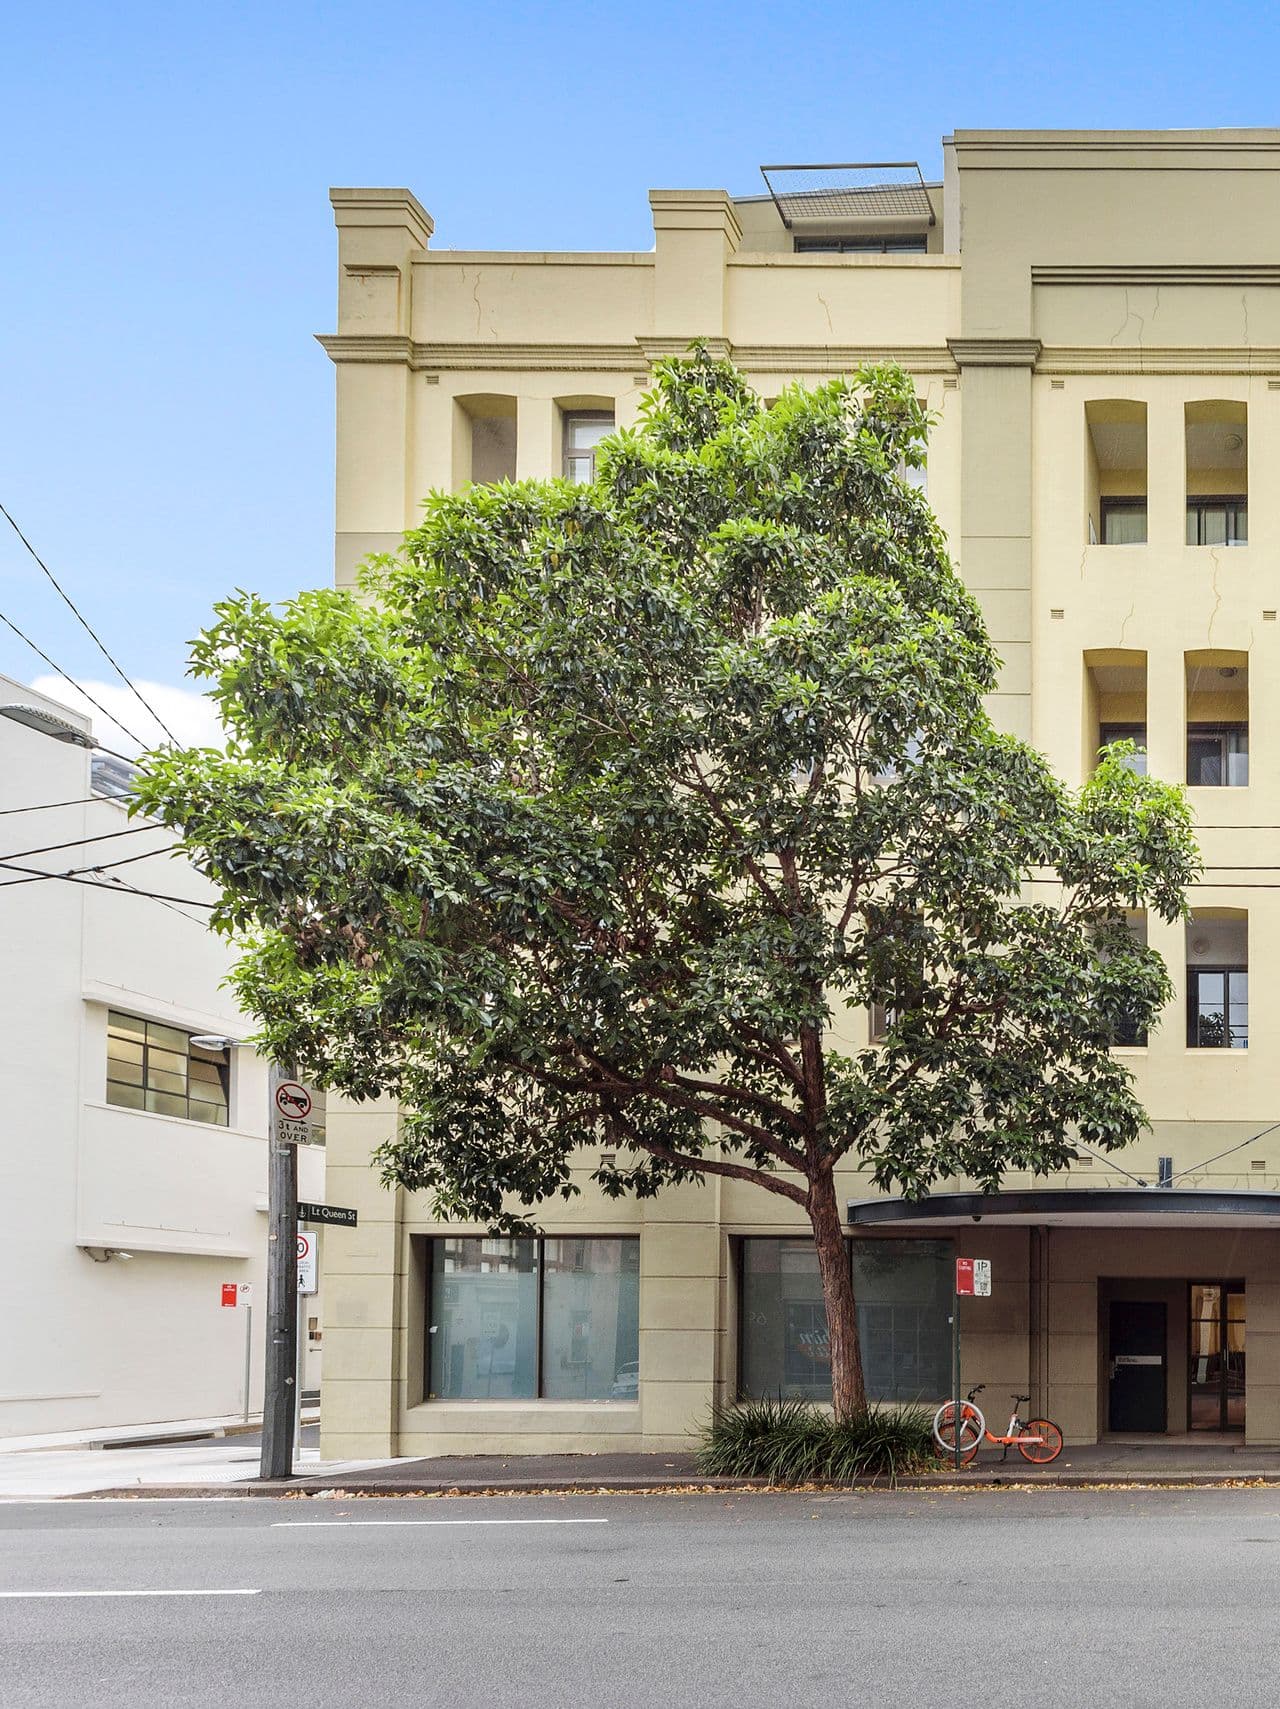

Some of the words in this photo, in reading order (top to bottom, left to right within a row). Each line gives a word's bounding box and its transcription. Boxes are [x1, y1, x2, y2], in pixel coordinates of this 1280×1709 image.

[280, 1131, 308, 1142] OVER
[311, 1206, 320, 1216] Lt
[321, 1207, 347, 1219] Queen
[347, 1210, 356, 1221] St
